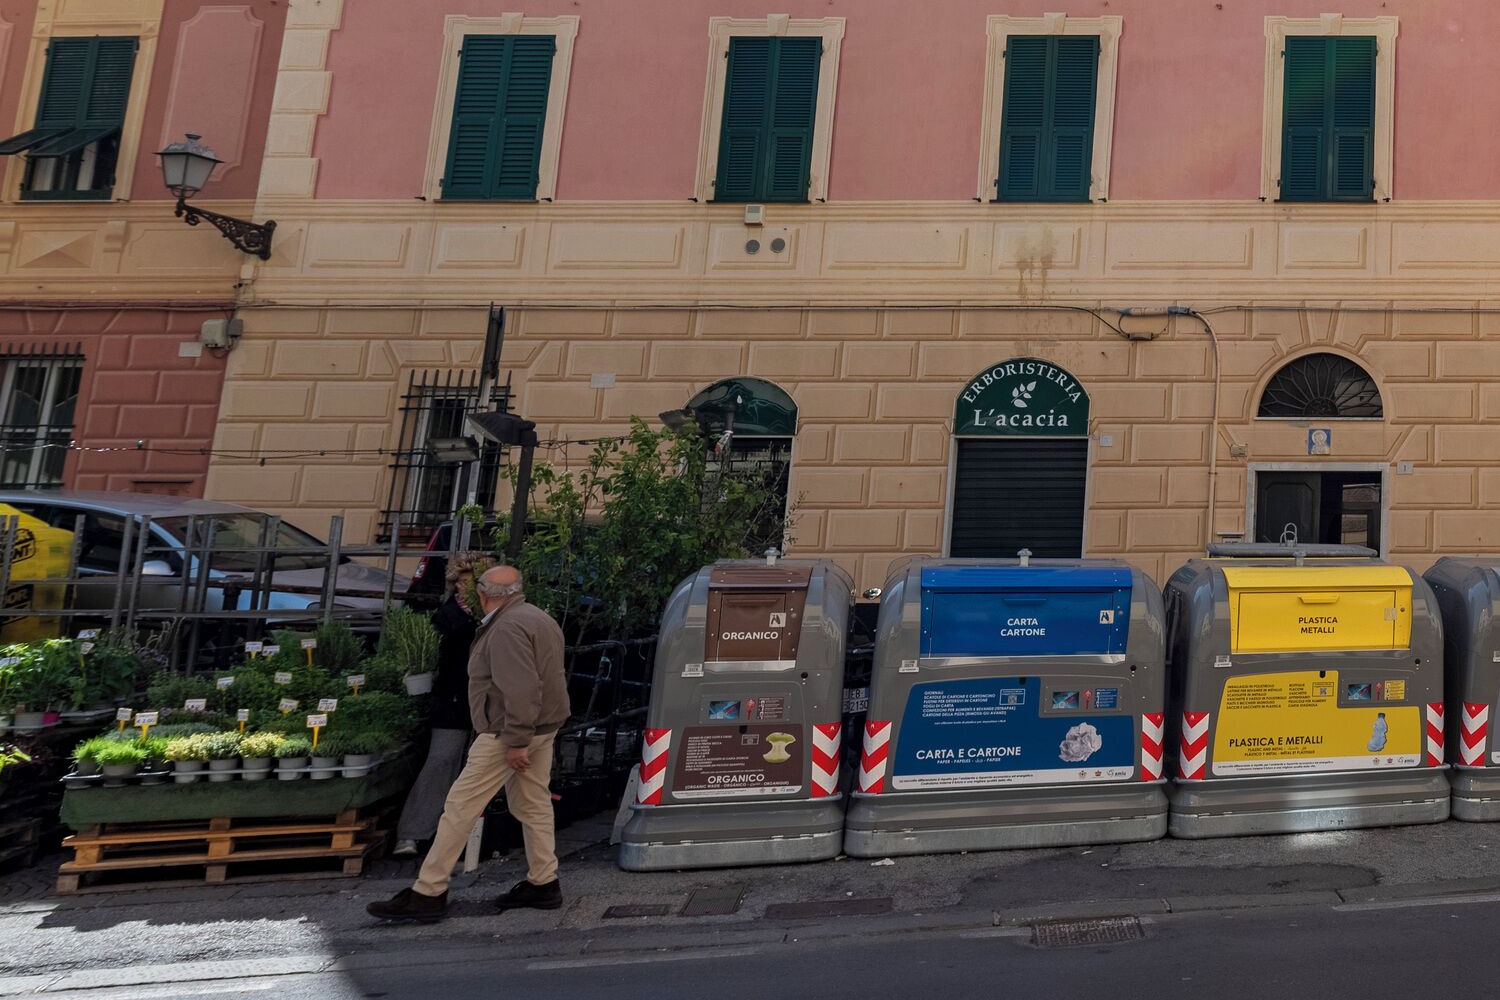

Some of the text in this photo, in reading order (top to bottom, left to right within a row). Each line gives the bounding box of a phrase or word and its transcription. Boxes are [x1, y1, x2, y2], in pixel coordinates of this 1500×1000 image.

[963, 363, 1081, 403] ERBORISTERIA
[974, 409, 1069, 427] L'acacia
[1007, 618, 1039, 626] CARTA
[1298, 616, 1338, 624] PLASTICA
[1000, 628, 1046, 637] CARTONE
[1300, 626, 1335, 634] METALLI
[722, 631, 779, 640] ORGANICO
[1229, 736, 1324, 748] PLASTICA E METALLI
[916, 746, 1022, 760] CARTA E CARTONE
[707, 773, 765, 784] ORGANICO
